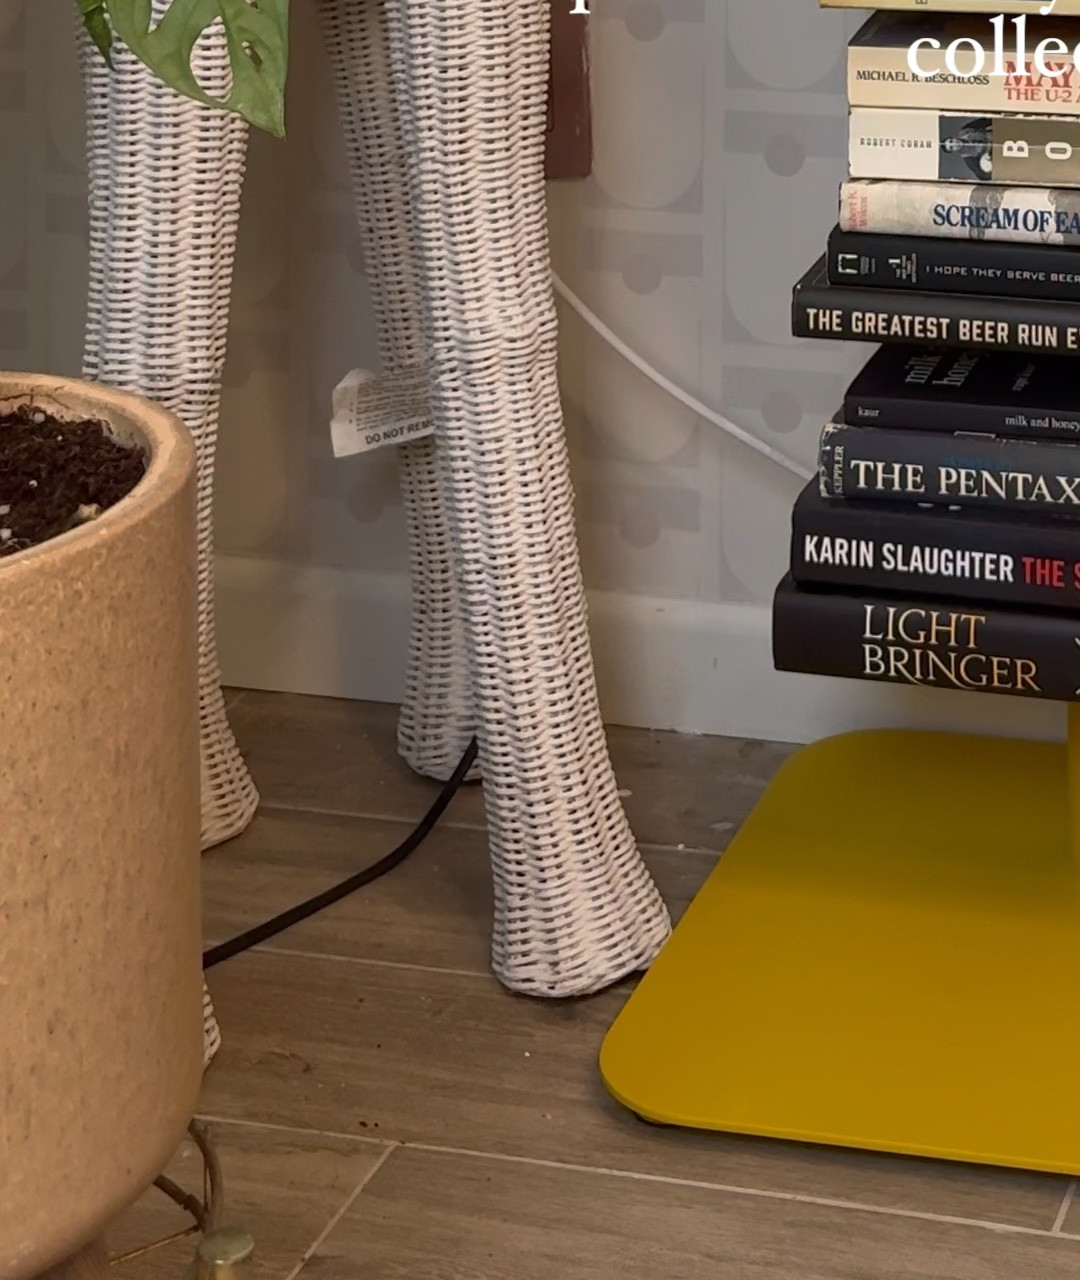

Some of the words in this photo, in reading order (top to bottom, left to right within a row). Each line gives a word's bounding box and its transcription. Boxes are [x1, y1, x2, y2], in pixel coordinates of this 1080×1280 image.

[806, 308, 843, 331] THE
[852, 311, 950, 339] GREATEST
[959, 320, 1009, 344] BEER
[1018, 323, 1058, 347] RUN
[365, 434, 381, 445] DO
[383, 427, 405, 440] NOT
[1005, 416, 1027, 427] milk
[1031, 418, 1049, 428] and
[851, 459, 925, 492] THE
[804, 534, 874, 567] KARIN
[882, 542, 1014, 582] SLAUGHTER
[1022, 556, 1065, 587] THE
[863, 604, 986, 649] LIGHT
[861, 644, 1042, 692] BRINGER
